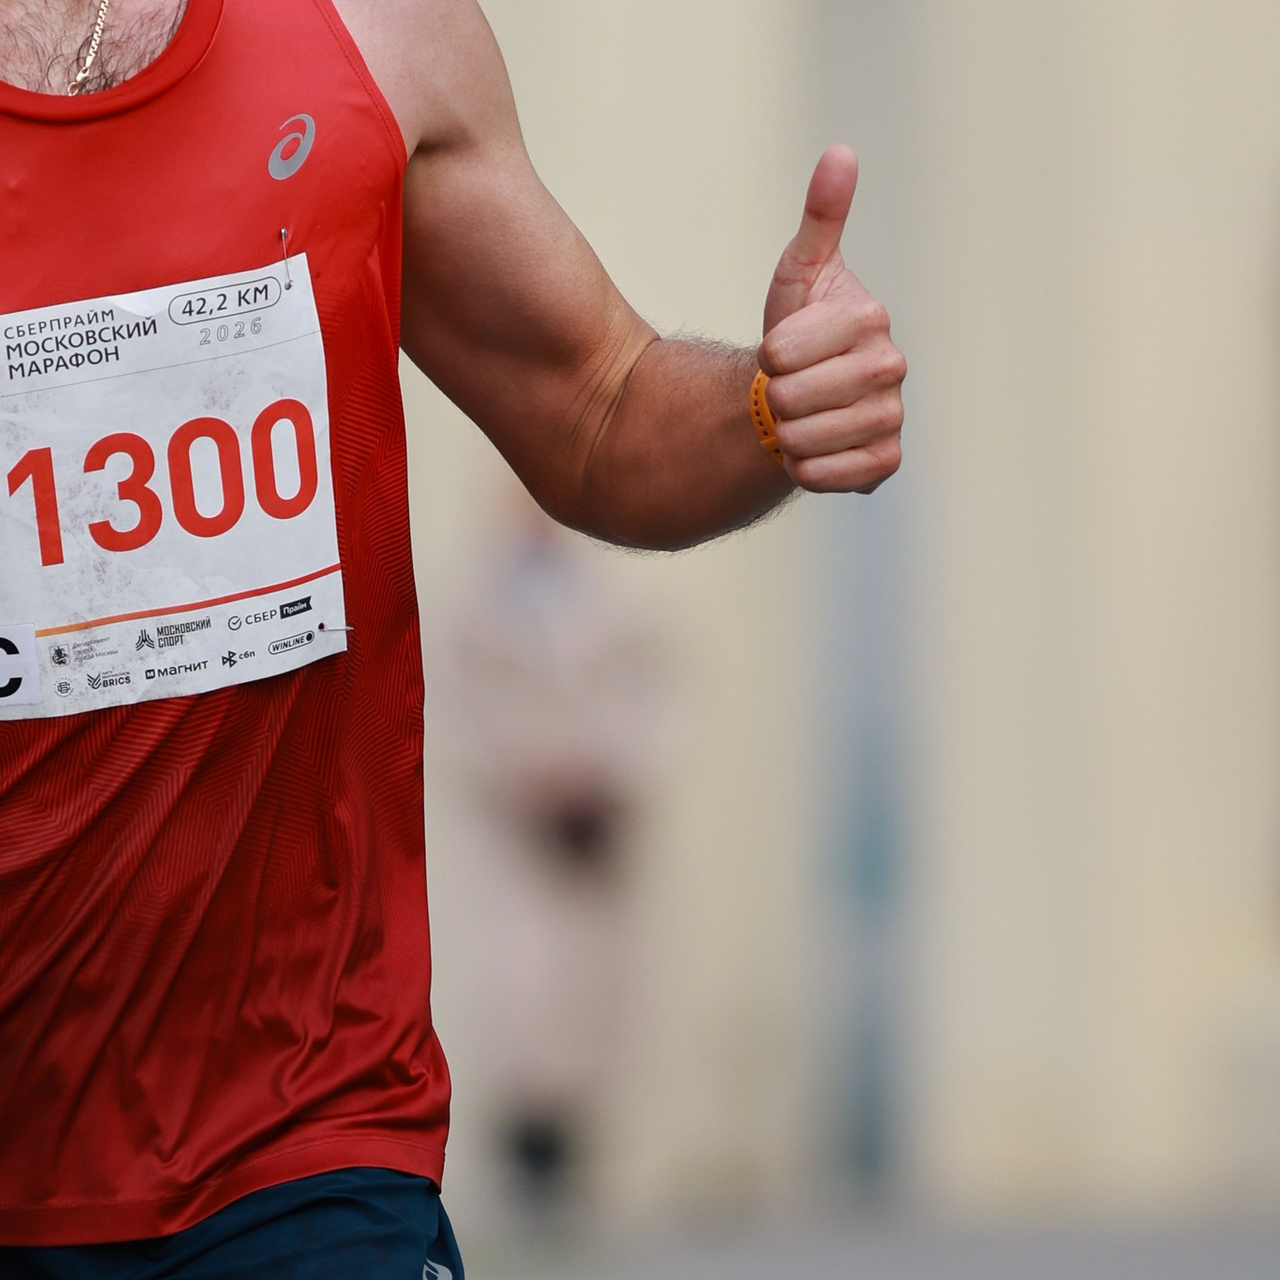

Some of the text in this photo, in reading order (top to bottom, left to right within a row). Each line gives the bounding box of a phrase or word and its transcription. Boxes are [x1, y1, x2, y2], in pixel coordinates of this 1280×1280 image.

[182, 293, 227, 317] 42,2
[4, 308, 115, 339] СБЕРПРАЙМ
[199, 317, 262, 346] 2026
[6, 316, 158, 360] МОСКОВСКИЙ
[8, 346, 120, 380] МАРАФОН
[245, 601, 308, 625] СБЕР Прайм
[156, 616, 212, 637] МОСКОВСКИЙ
[158, 634, 184, 648] СПОРТ
[272, 635, 305, 652] WINLINE
[102, 676, 132, 688] BRICS
